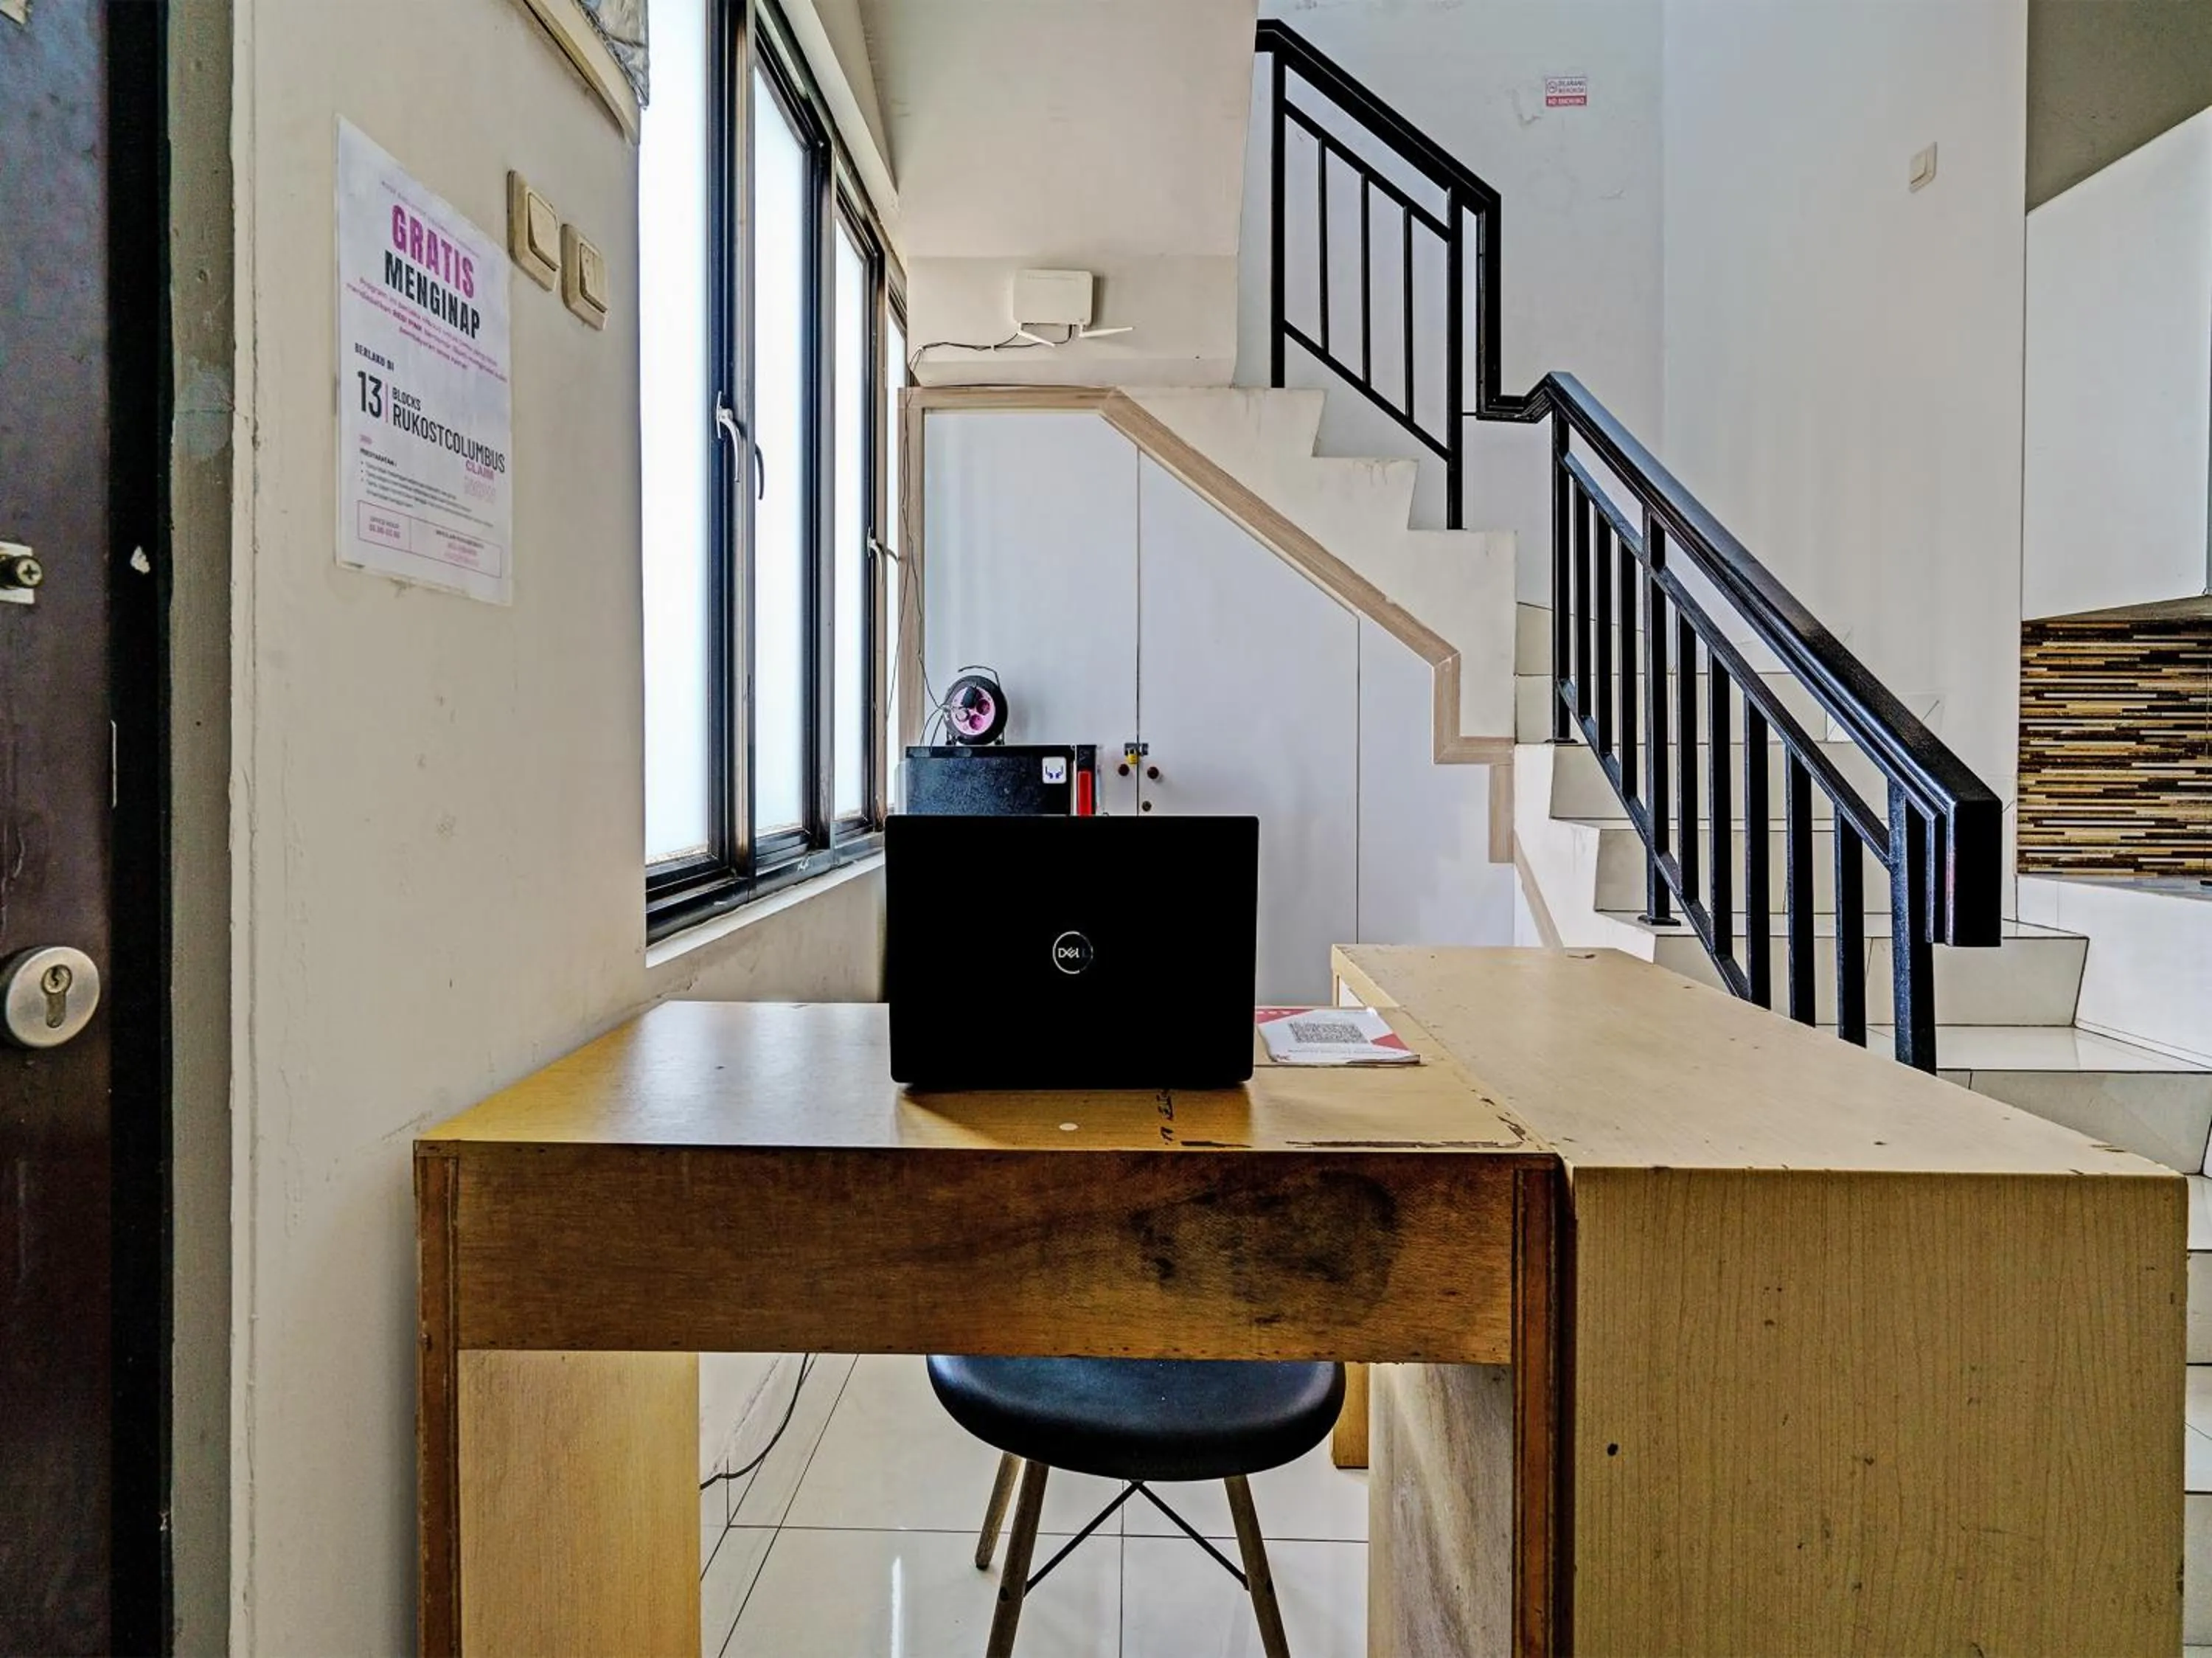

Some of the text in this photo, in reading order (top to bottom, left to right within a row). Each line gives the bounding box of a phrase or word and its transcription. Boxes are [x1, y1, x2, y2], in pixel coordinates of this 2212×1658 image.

[392, 204, 474, 299] GRATIS
[384, 249, 481, 339] MENGINAP
[355, 342, 394, 372] BERLAKU DI
[358, 370, 383, 419] 13
[392, 386, 421, 412] BLOCKS
[393, 403, 506, 474] RUKOSTCOLUMBUS
[1058, 947, 1090, 959] DELL
